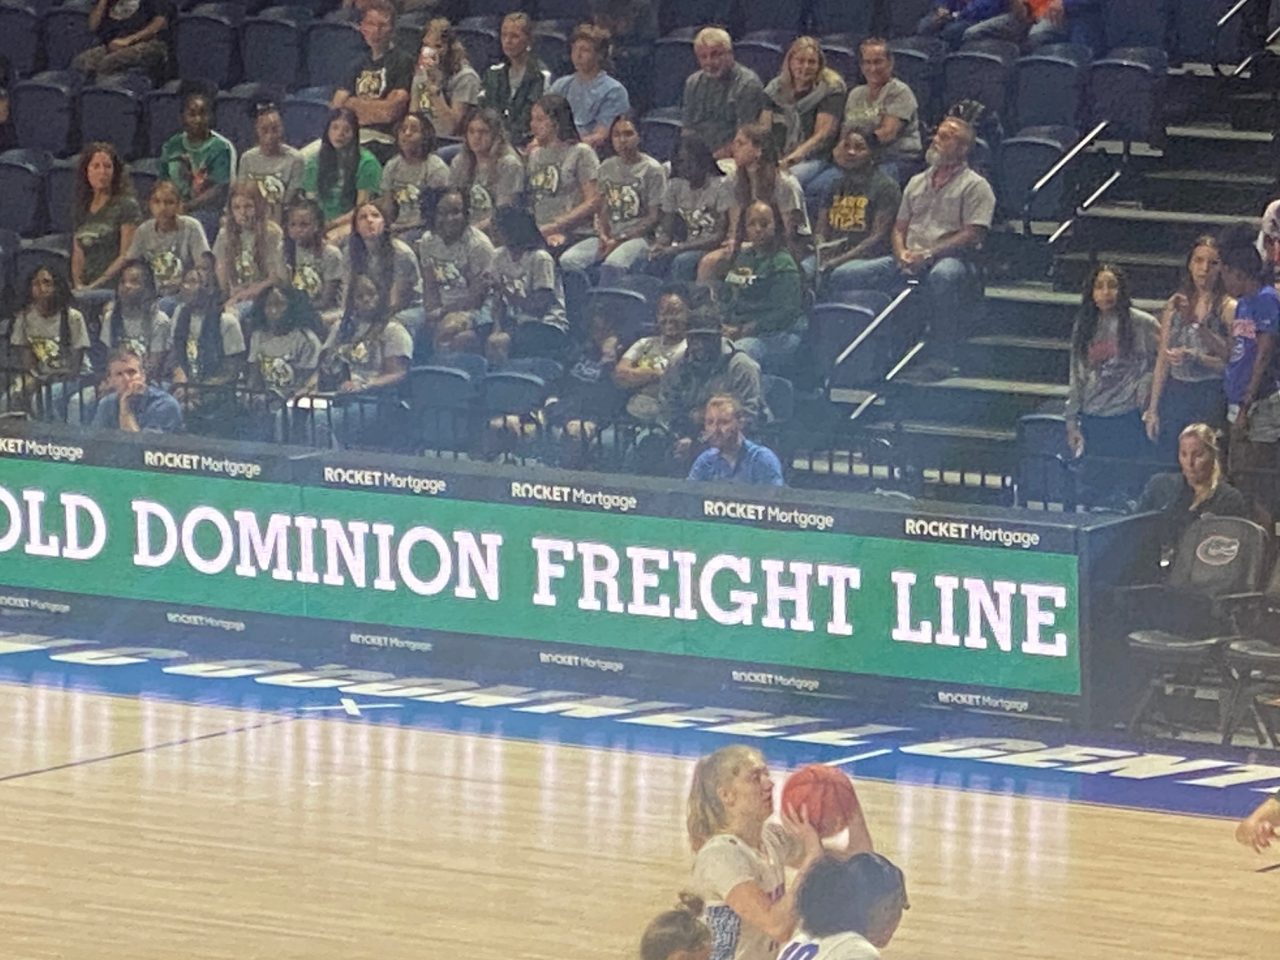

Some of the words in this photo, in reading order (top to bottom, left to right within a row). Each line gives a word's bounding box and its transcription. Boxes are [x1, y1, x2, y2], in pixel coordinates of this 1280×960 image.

[25, 440, 83, 461] Mortgage
[144, 451, 200, 469] ROCKET
[201, 457, 261, 478] Mortgage
[324, 467, 382, 486] ROCKET
[384, 472, 446, 494] Mortgage
[511, 482, 571, 501] ROCKET
[573, 488, 637, 511] Mortgage
[704, 501, 765, 520] ROCKET
[767, 507, 834, 530] Mortgage
[905, 519, 968, 538] ROCKET
[971, 524, 1039, 548] Mortgage
[131, 499, 502, 601] DOMINION
[531, 537, 861, 636] FREIGHT
[891, 570, 1067, 656] LINE
[539, 652, 580, 666] ROCKET
[581, 655, 624, 672] Mortgage
[732, 671, 773, 685] ROCKET
[774, 675, 819, 690] Mortgage
[938, 692, 981, 706] ROCKET
[982, 695, 1028, 711] Mortgage
